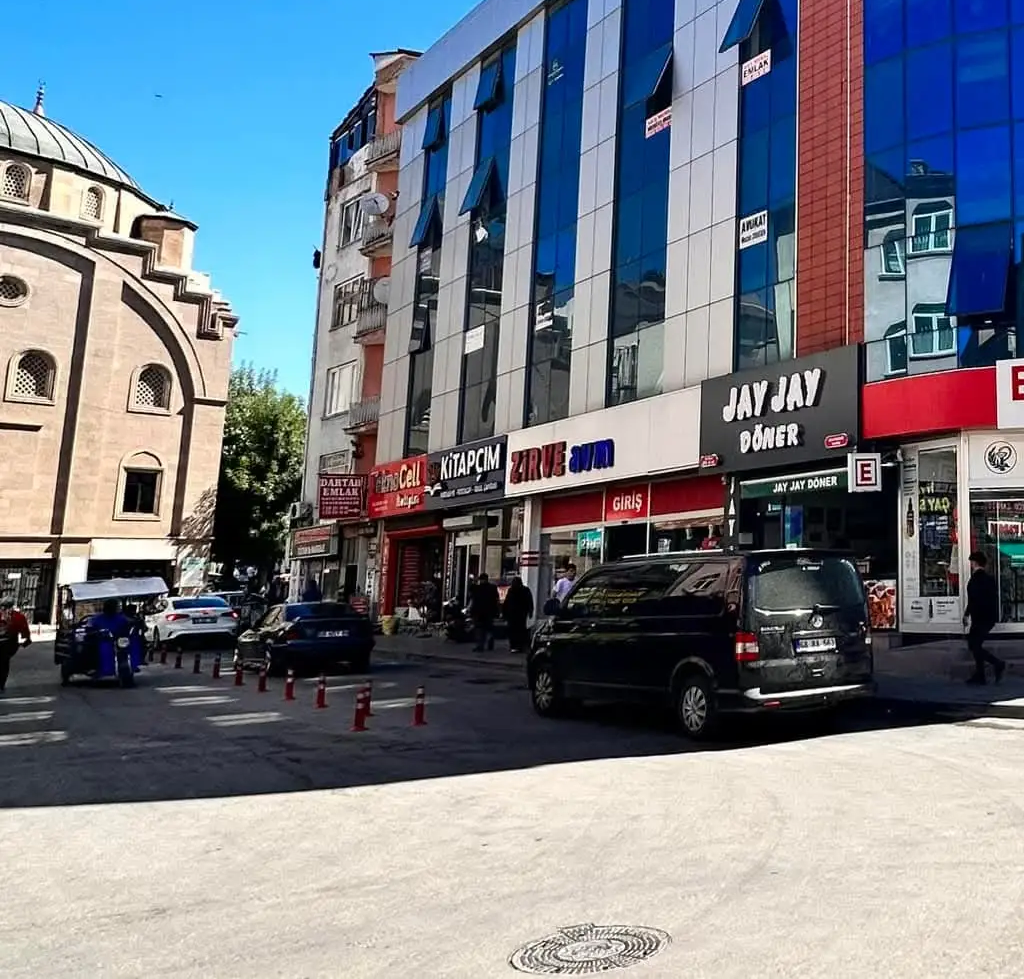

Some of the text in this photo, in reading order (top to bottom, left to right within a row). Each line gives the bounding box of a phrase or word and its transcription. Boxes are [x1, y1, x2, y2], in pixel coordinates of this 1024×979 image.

[743, 60, 769, 78] EMLAK
[723, 368, 821, 422] JAY JAY
[740, 423, 799, 453] DÖNER
[441, 444, 501, 482] KİTAPÇIM
[510, 438, 615, 484] ZİRVE avm
[860, 463, 872, 482] E
[773, 476, 838, 493] JAY JAY DÖNER
[612, 493, 643, 512] GİRİŞ
